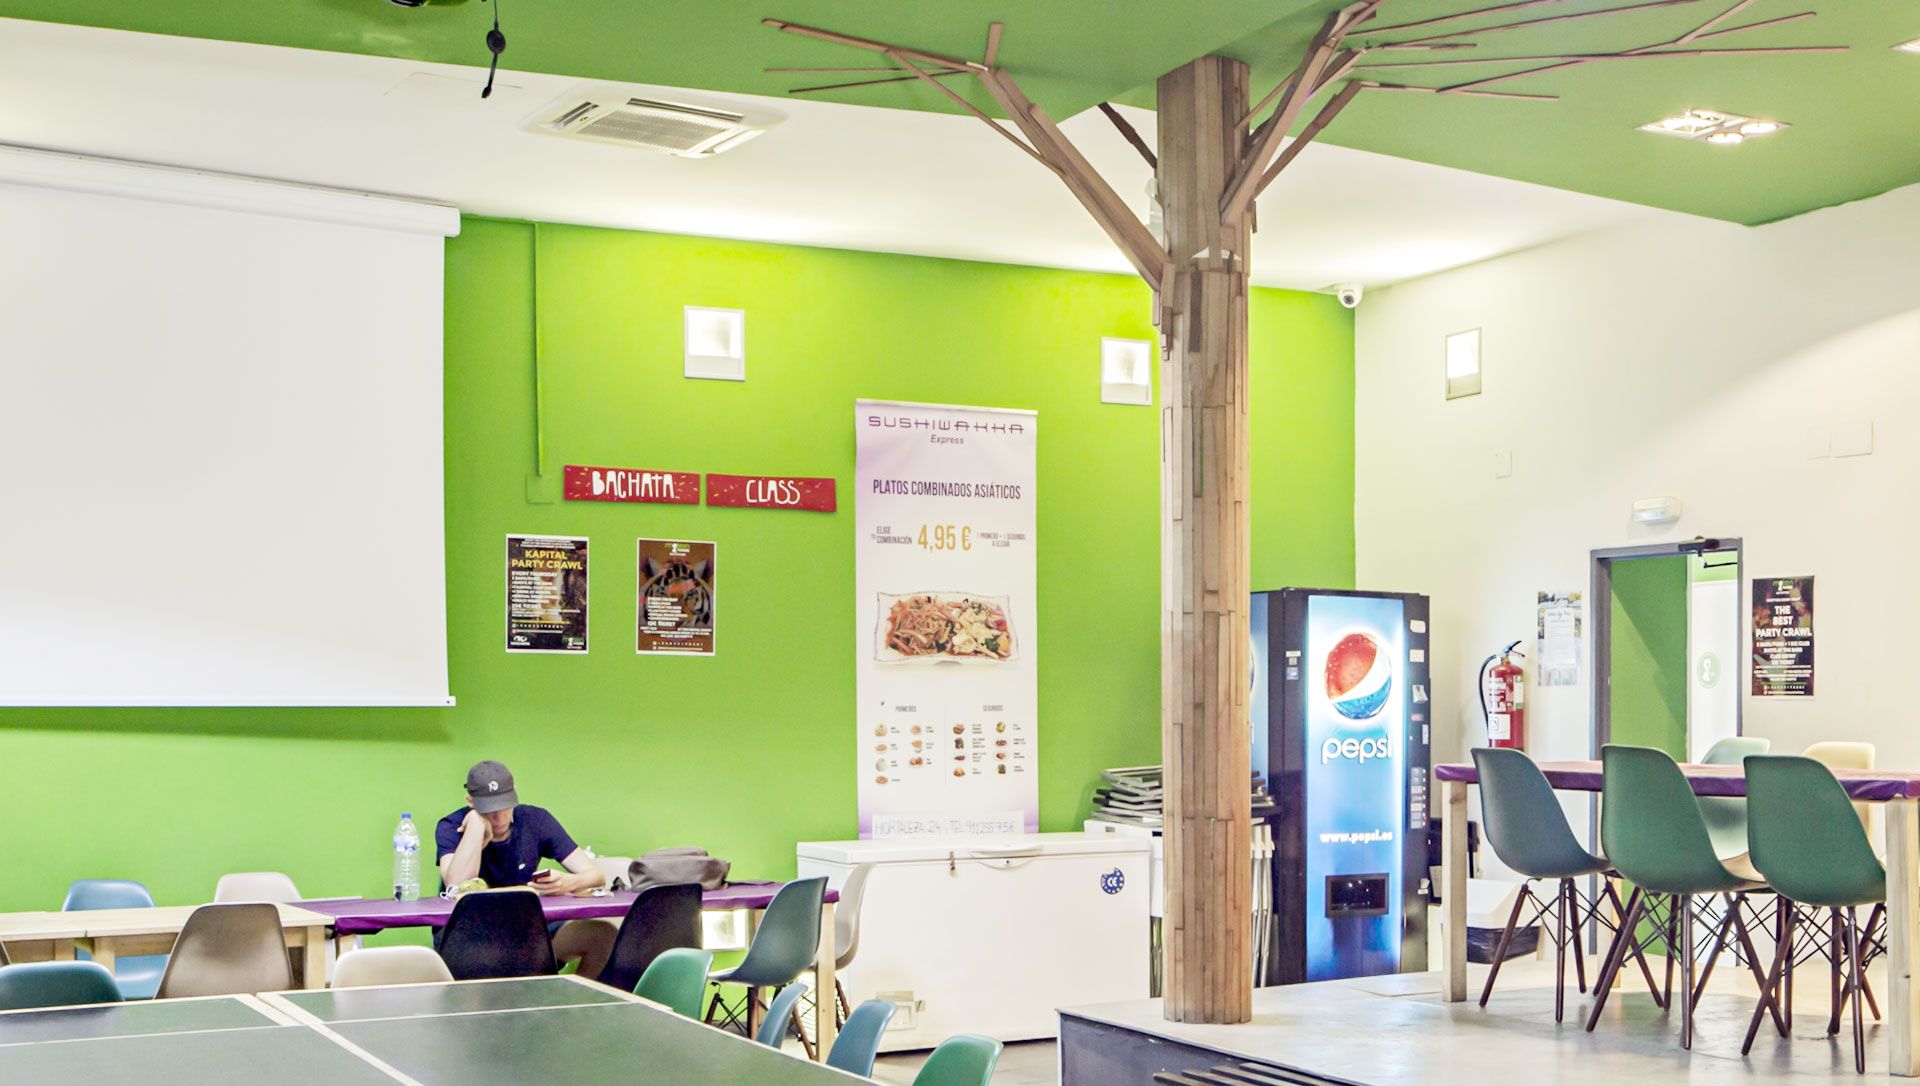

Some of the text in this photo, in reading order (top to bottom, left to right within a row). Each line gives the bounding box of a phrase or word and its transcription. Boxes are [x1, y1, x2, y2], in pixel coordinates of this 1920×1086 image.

[930, 434, 964, 445] Express
[591, 470, 675, 498] BACHATA
[873, 479, 1021, 500] PLATOS COMBINADOS ASIÁTICOS
[745, 479, 801, 505] CLASS
[917, 524, 972, 552] 4,95 €
[524, 550, 568, 560] KAPITAL
[511, 559, 583, 570] PARTY CRAWL
[1774, 605, 1791, 615] THE
[1772, 616, 1793, 626] BEST
[1755, 627, 1812, 638] PARTY CRAWL
[1321, 734, 1392, 765] pepsi
[1319, 829, 1393, 845] www.pepsi.es
